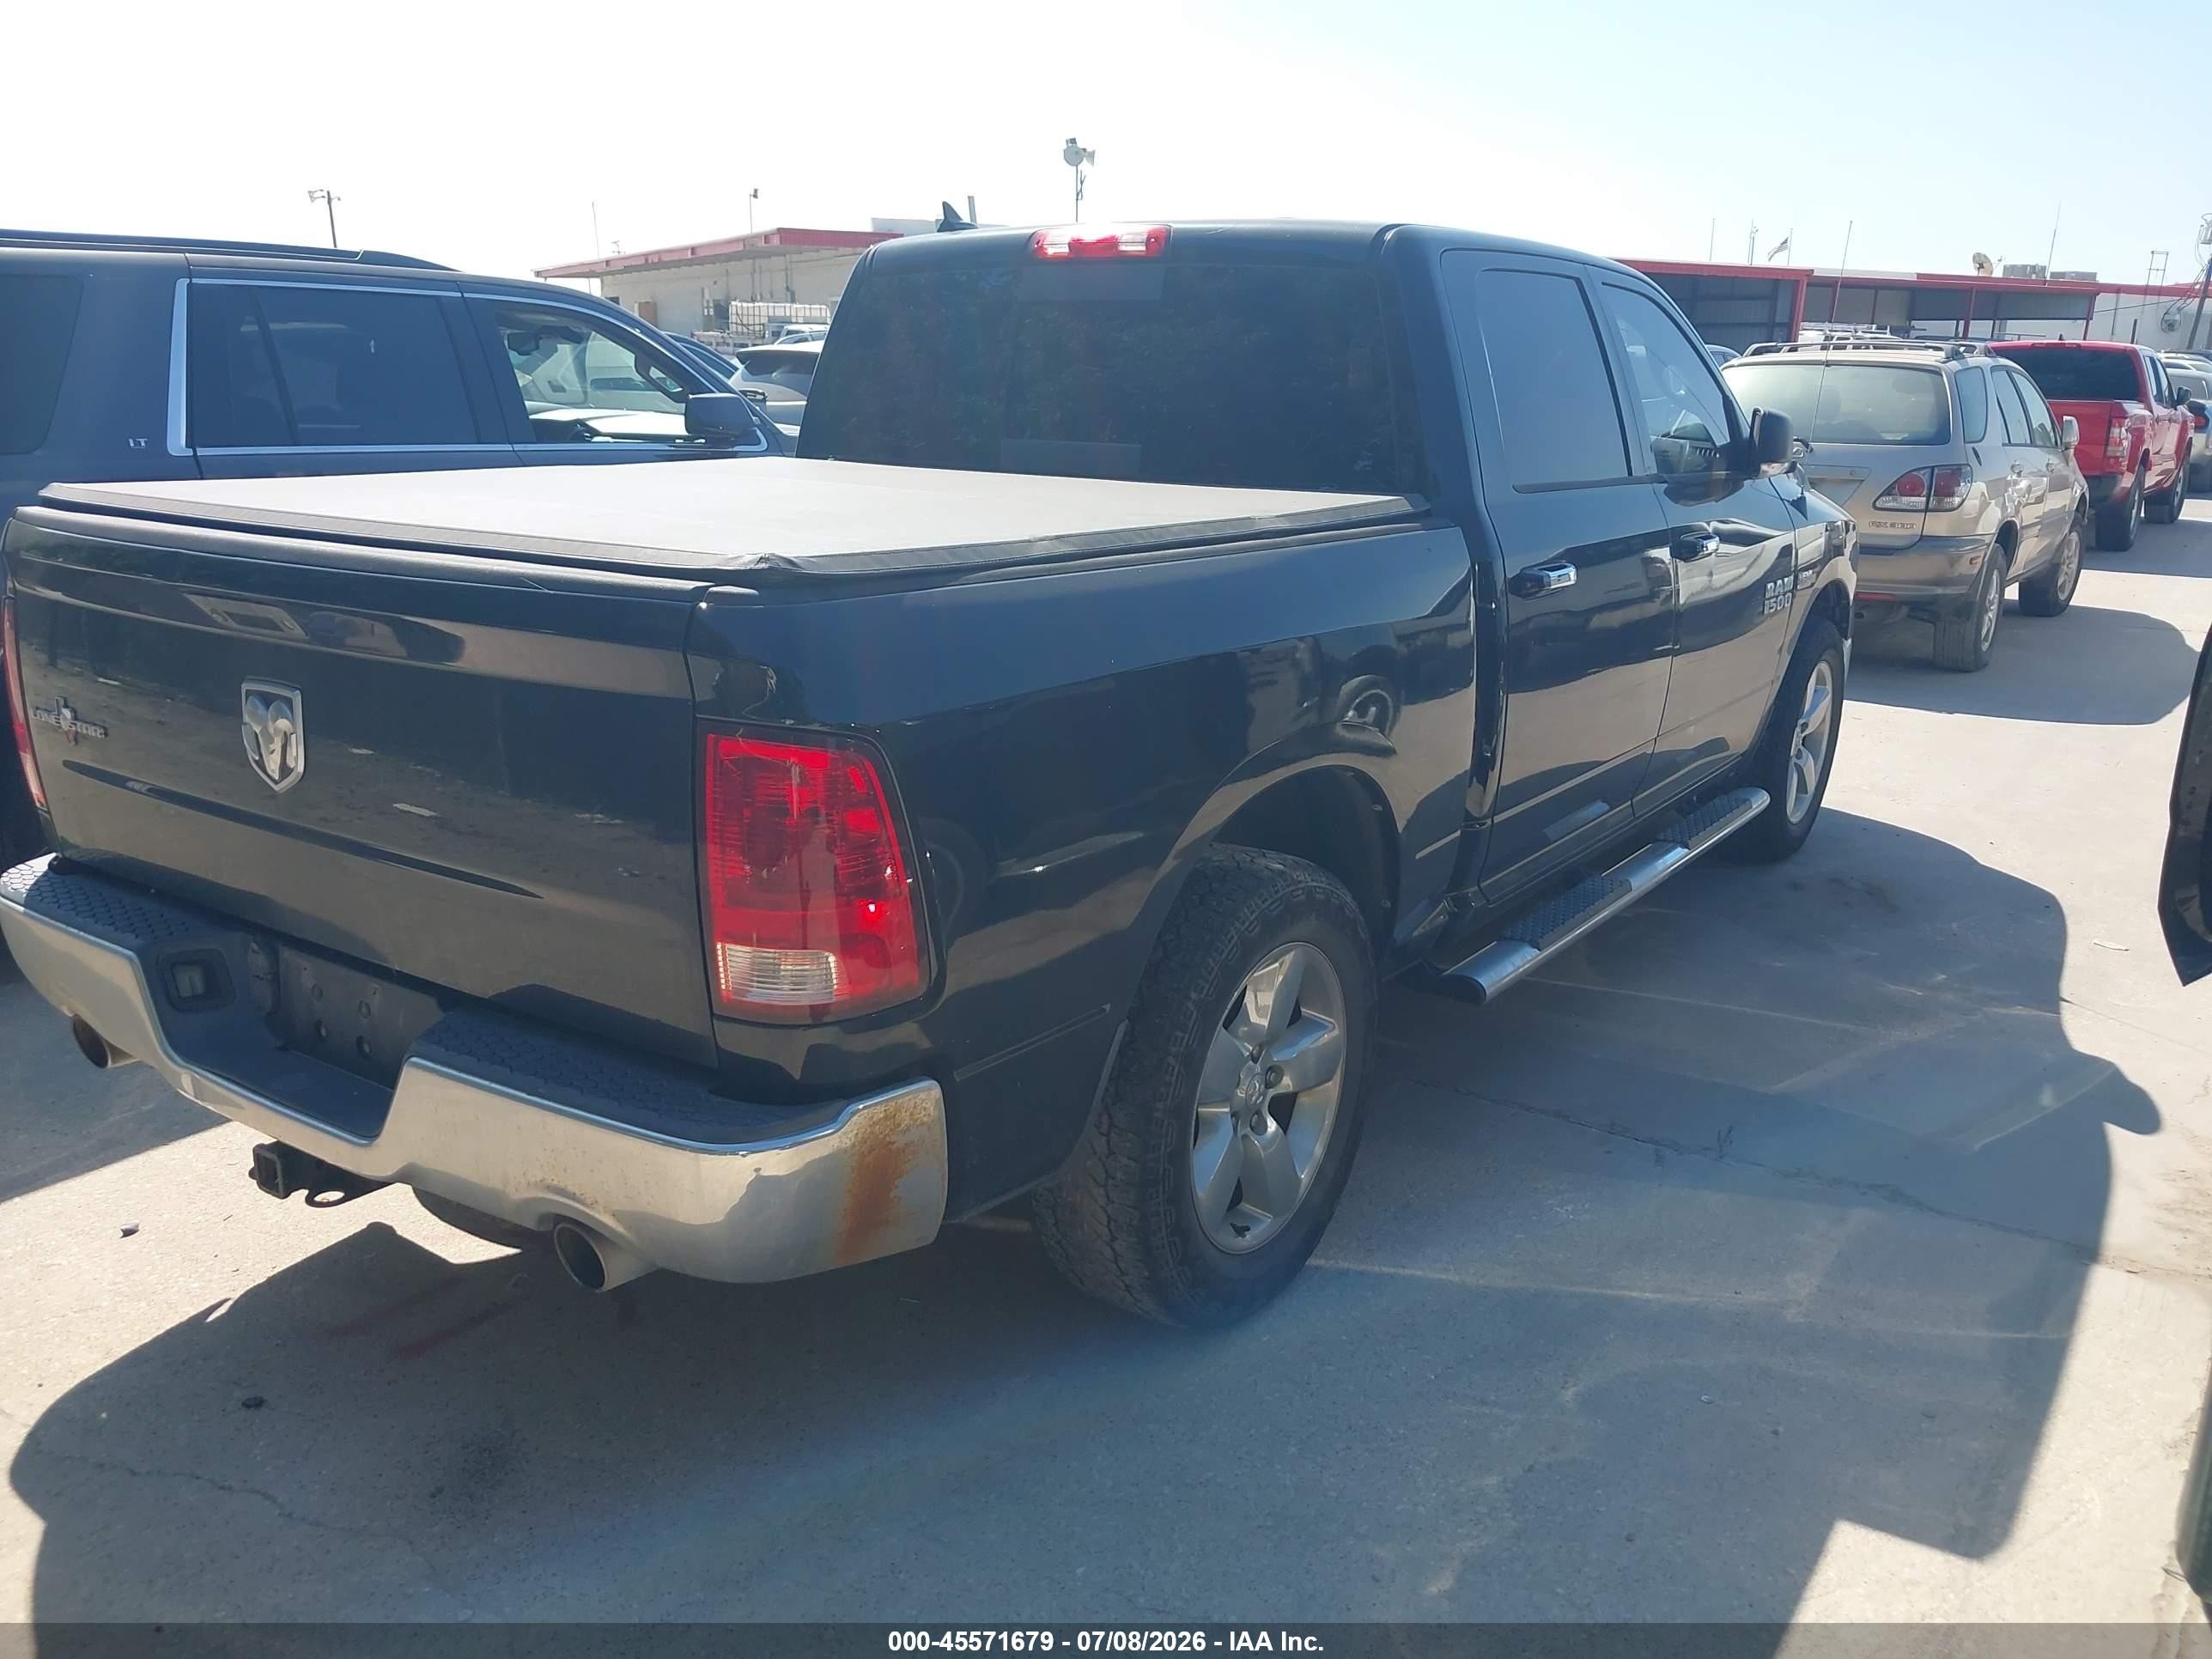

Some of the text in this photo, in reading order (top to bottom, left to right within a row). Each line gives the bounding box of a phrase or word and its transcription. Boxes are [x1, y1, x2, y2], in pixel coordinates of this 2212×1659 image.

[129, 438, 148, 447] LT
[1765, 574, 1794, 599] RAM
[1764, 592, 1792, 615] 1500
